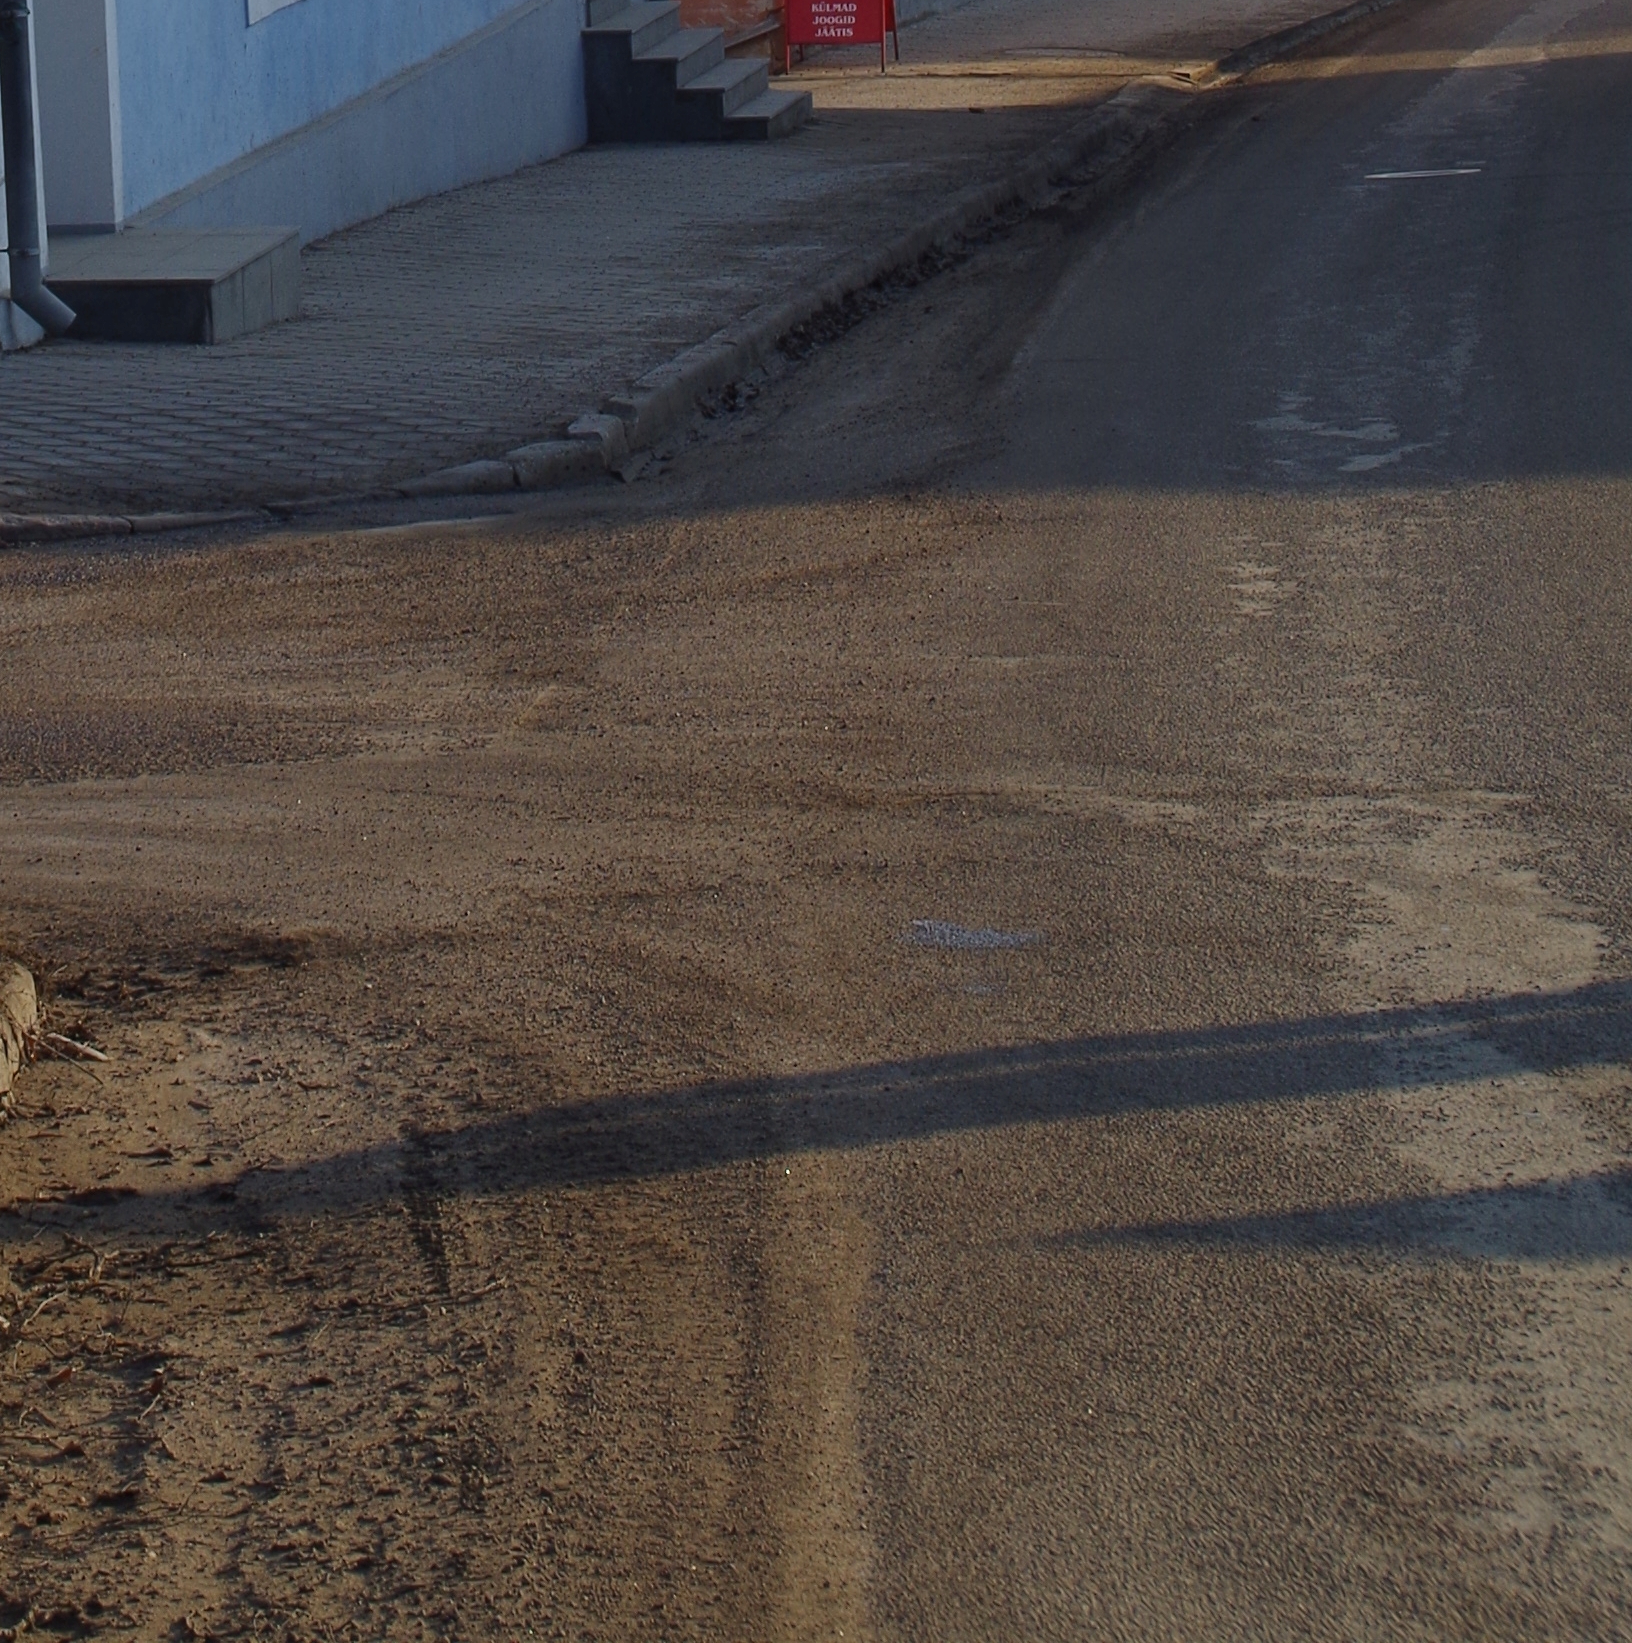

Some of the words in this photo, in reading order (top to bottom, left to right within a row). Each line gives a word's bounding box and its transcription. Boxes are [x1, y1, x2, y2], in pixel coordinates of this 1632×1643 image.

[811, 1, 857, 12] KÜLMAD
[812, 15, 856, 25] JOOGID
[814, 25, 854, 37] JÄÄTIS
